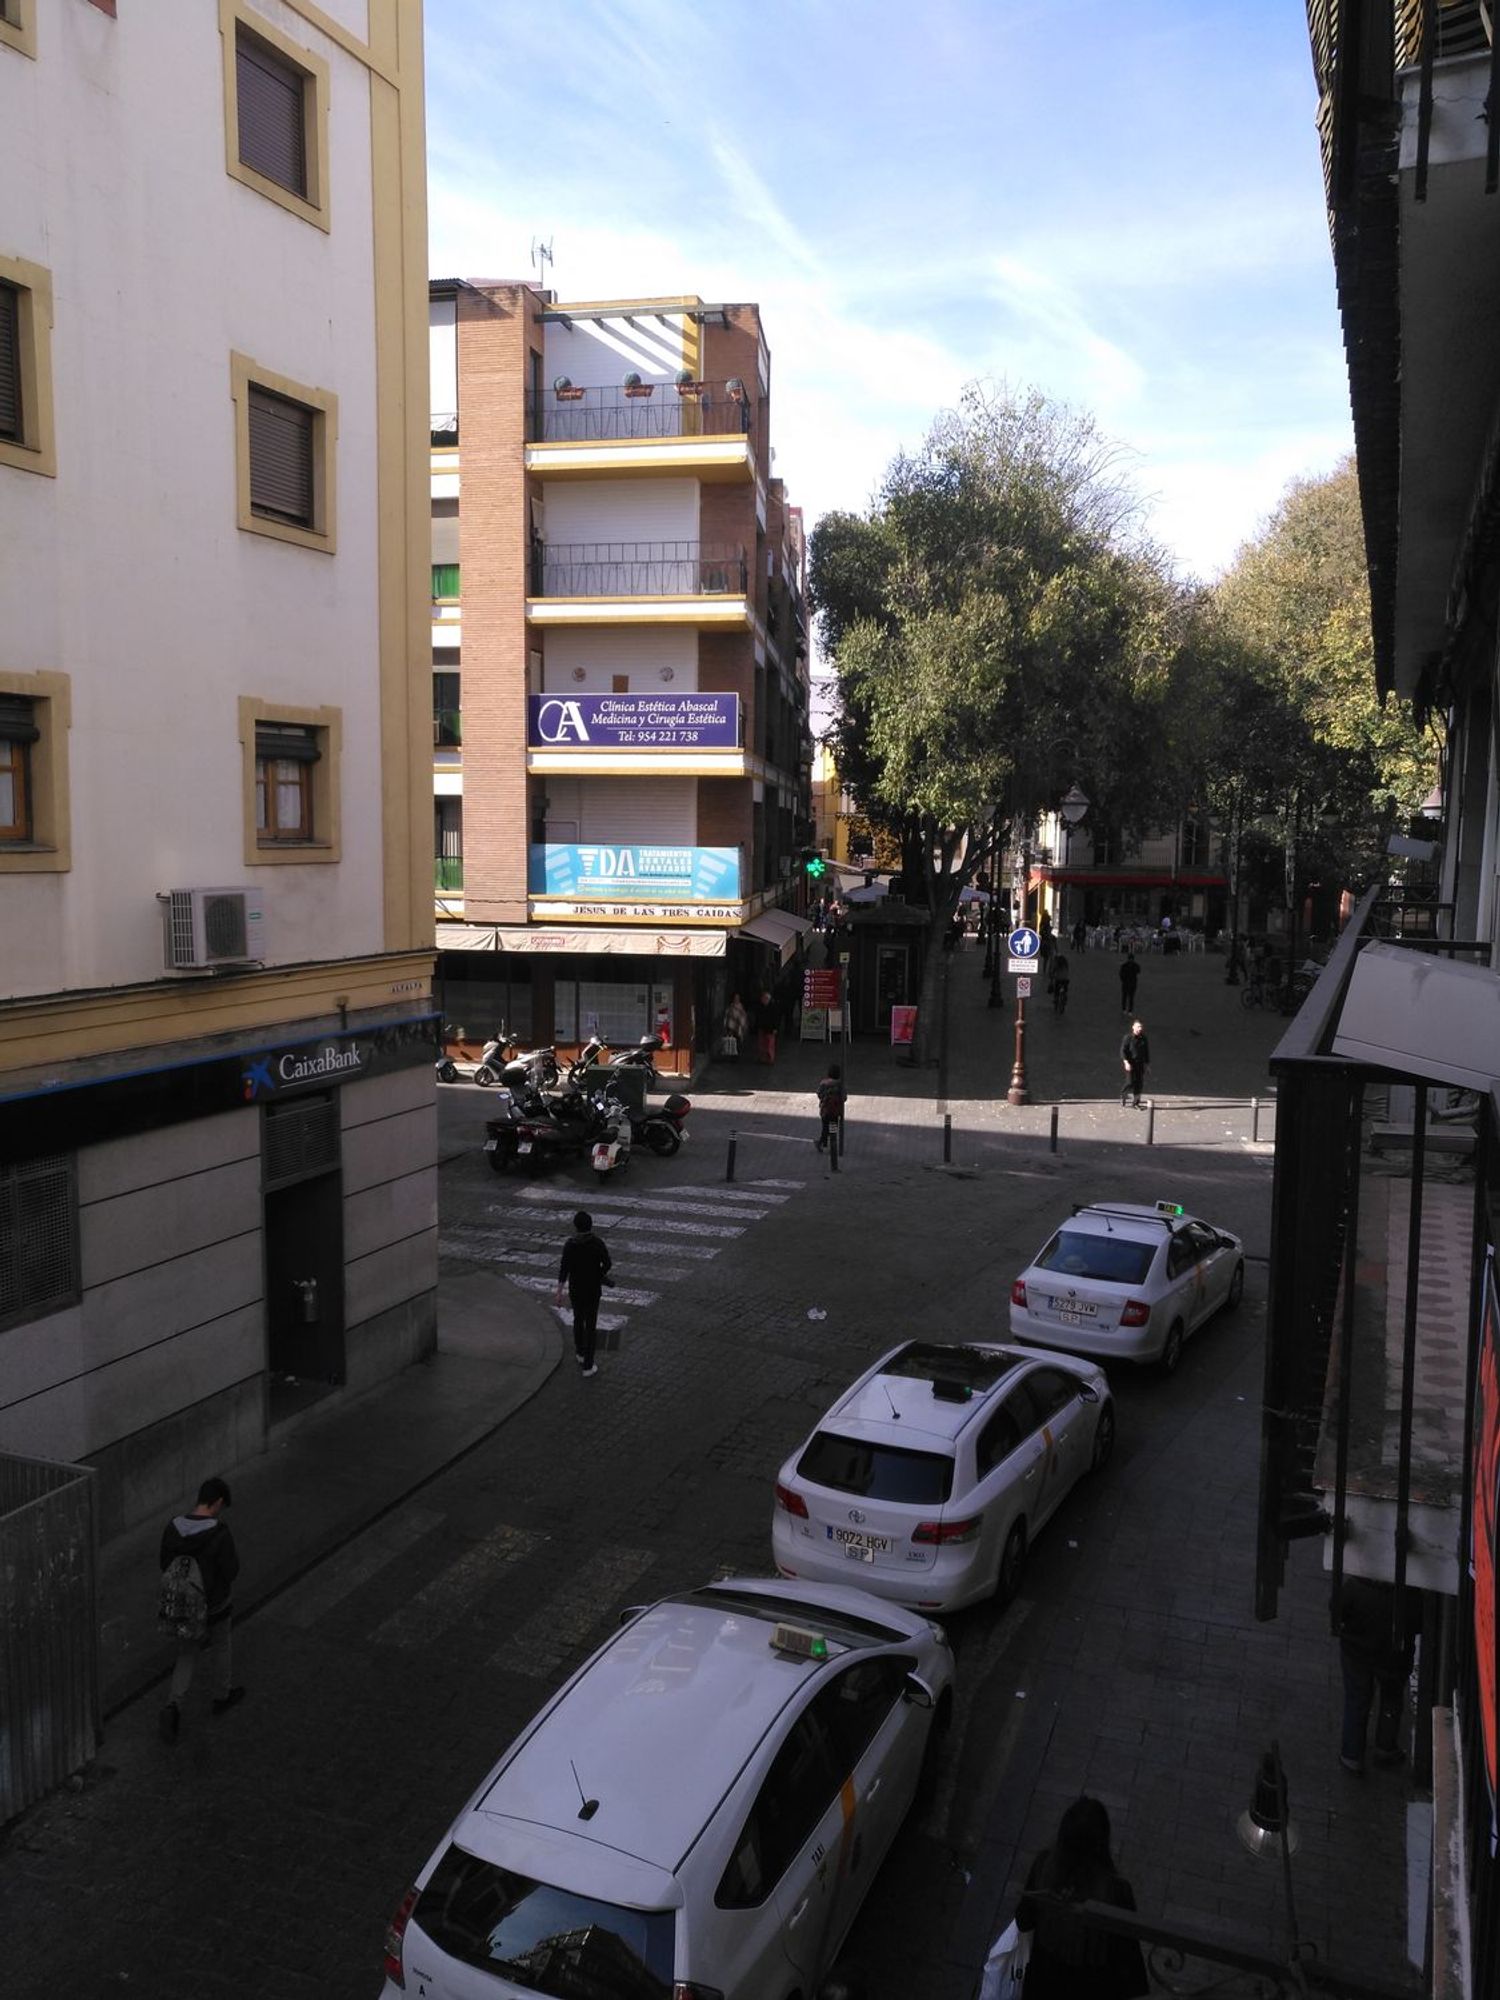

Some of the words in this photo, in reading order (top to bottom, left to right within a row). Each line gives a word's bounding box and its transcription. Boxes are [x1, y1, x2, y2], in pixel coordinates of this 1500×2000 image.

[600, 700, 635, 712] Clínica
[637, 700, 676, 712] Estética
[678, 700, 718, 712] Abascal
[591, 713, 637, 725] Medicina
[647, 713, 685, 727] Cirugía
[687, 713, 727, 725] Estética
[637, 731, 656, 742] 954
[657, 731, 677, 742] 221
[679, 731, 699, 742] 738
[613, 907, 627, 915] DE
[634, 907, 655, 915] LAS
[662, 908, 690, 917] TRES
[279, 1043, 361, 1081] CaixaBank
[835, 1529, 863, 1546] 9072
[866, 1537, 888, 1550] HGV
